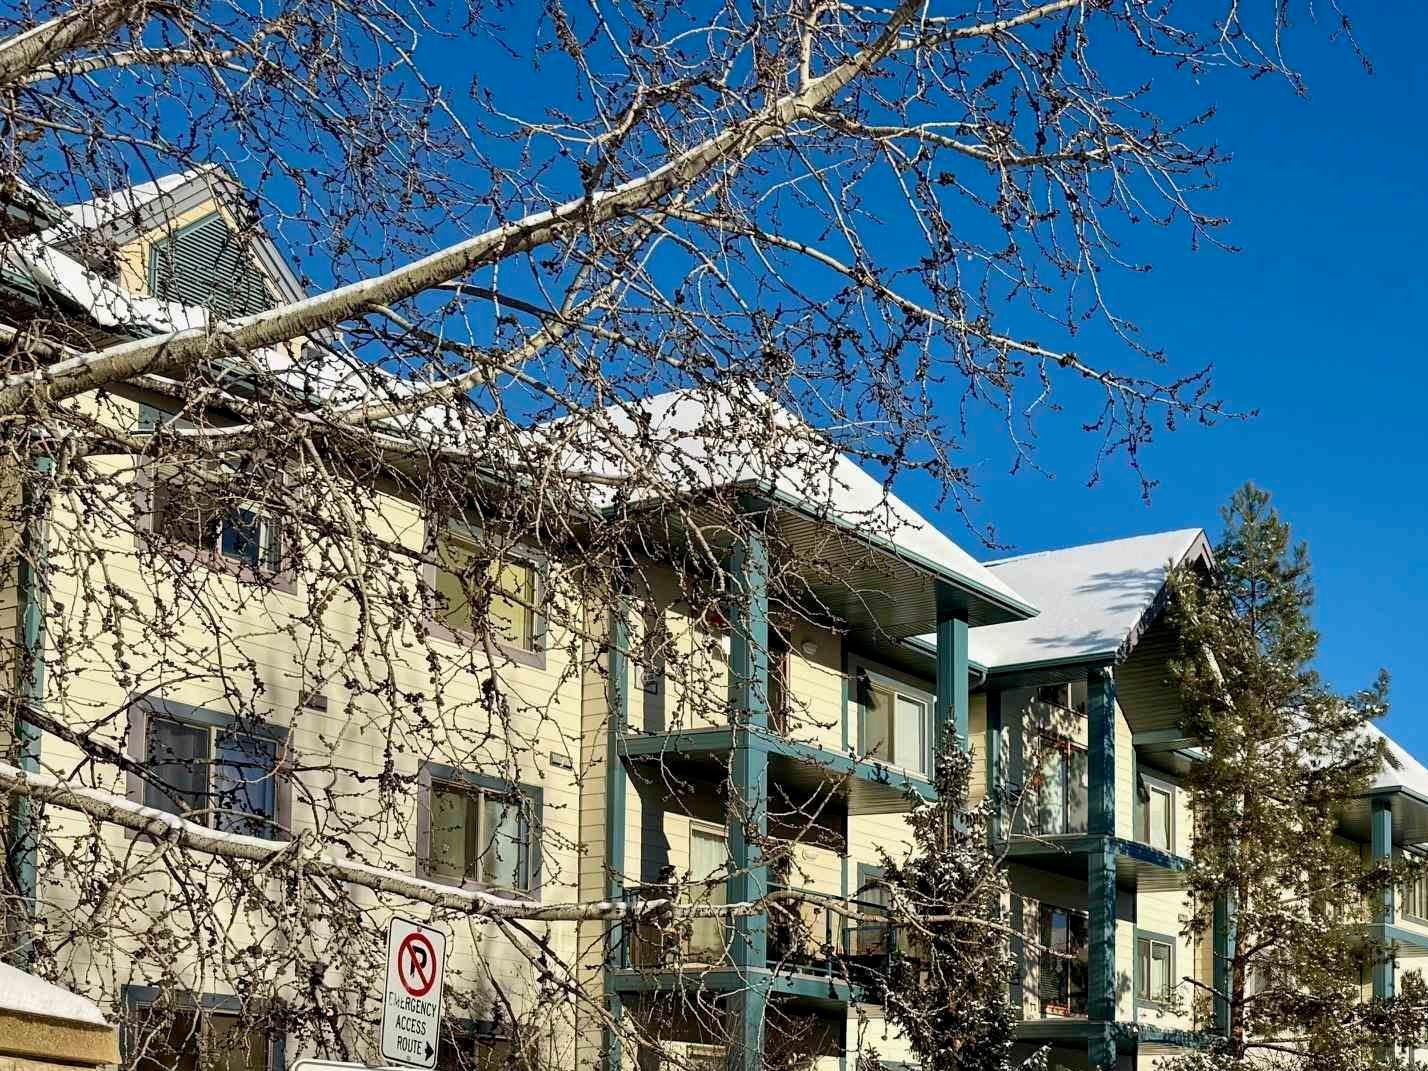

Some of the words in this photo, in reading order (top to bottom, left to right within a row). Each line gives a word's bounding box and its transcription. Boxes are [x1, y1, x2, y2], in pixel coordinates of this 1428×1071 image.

[388, 992, 437, 1018] EMERGENCY
[395, 1015, 427, 1035] ACCESS
[397, 1035, 422, 1055] ROUTE
